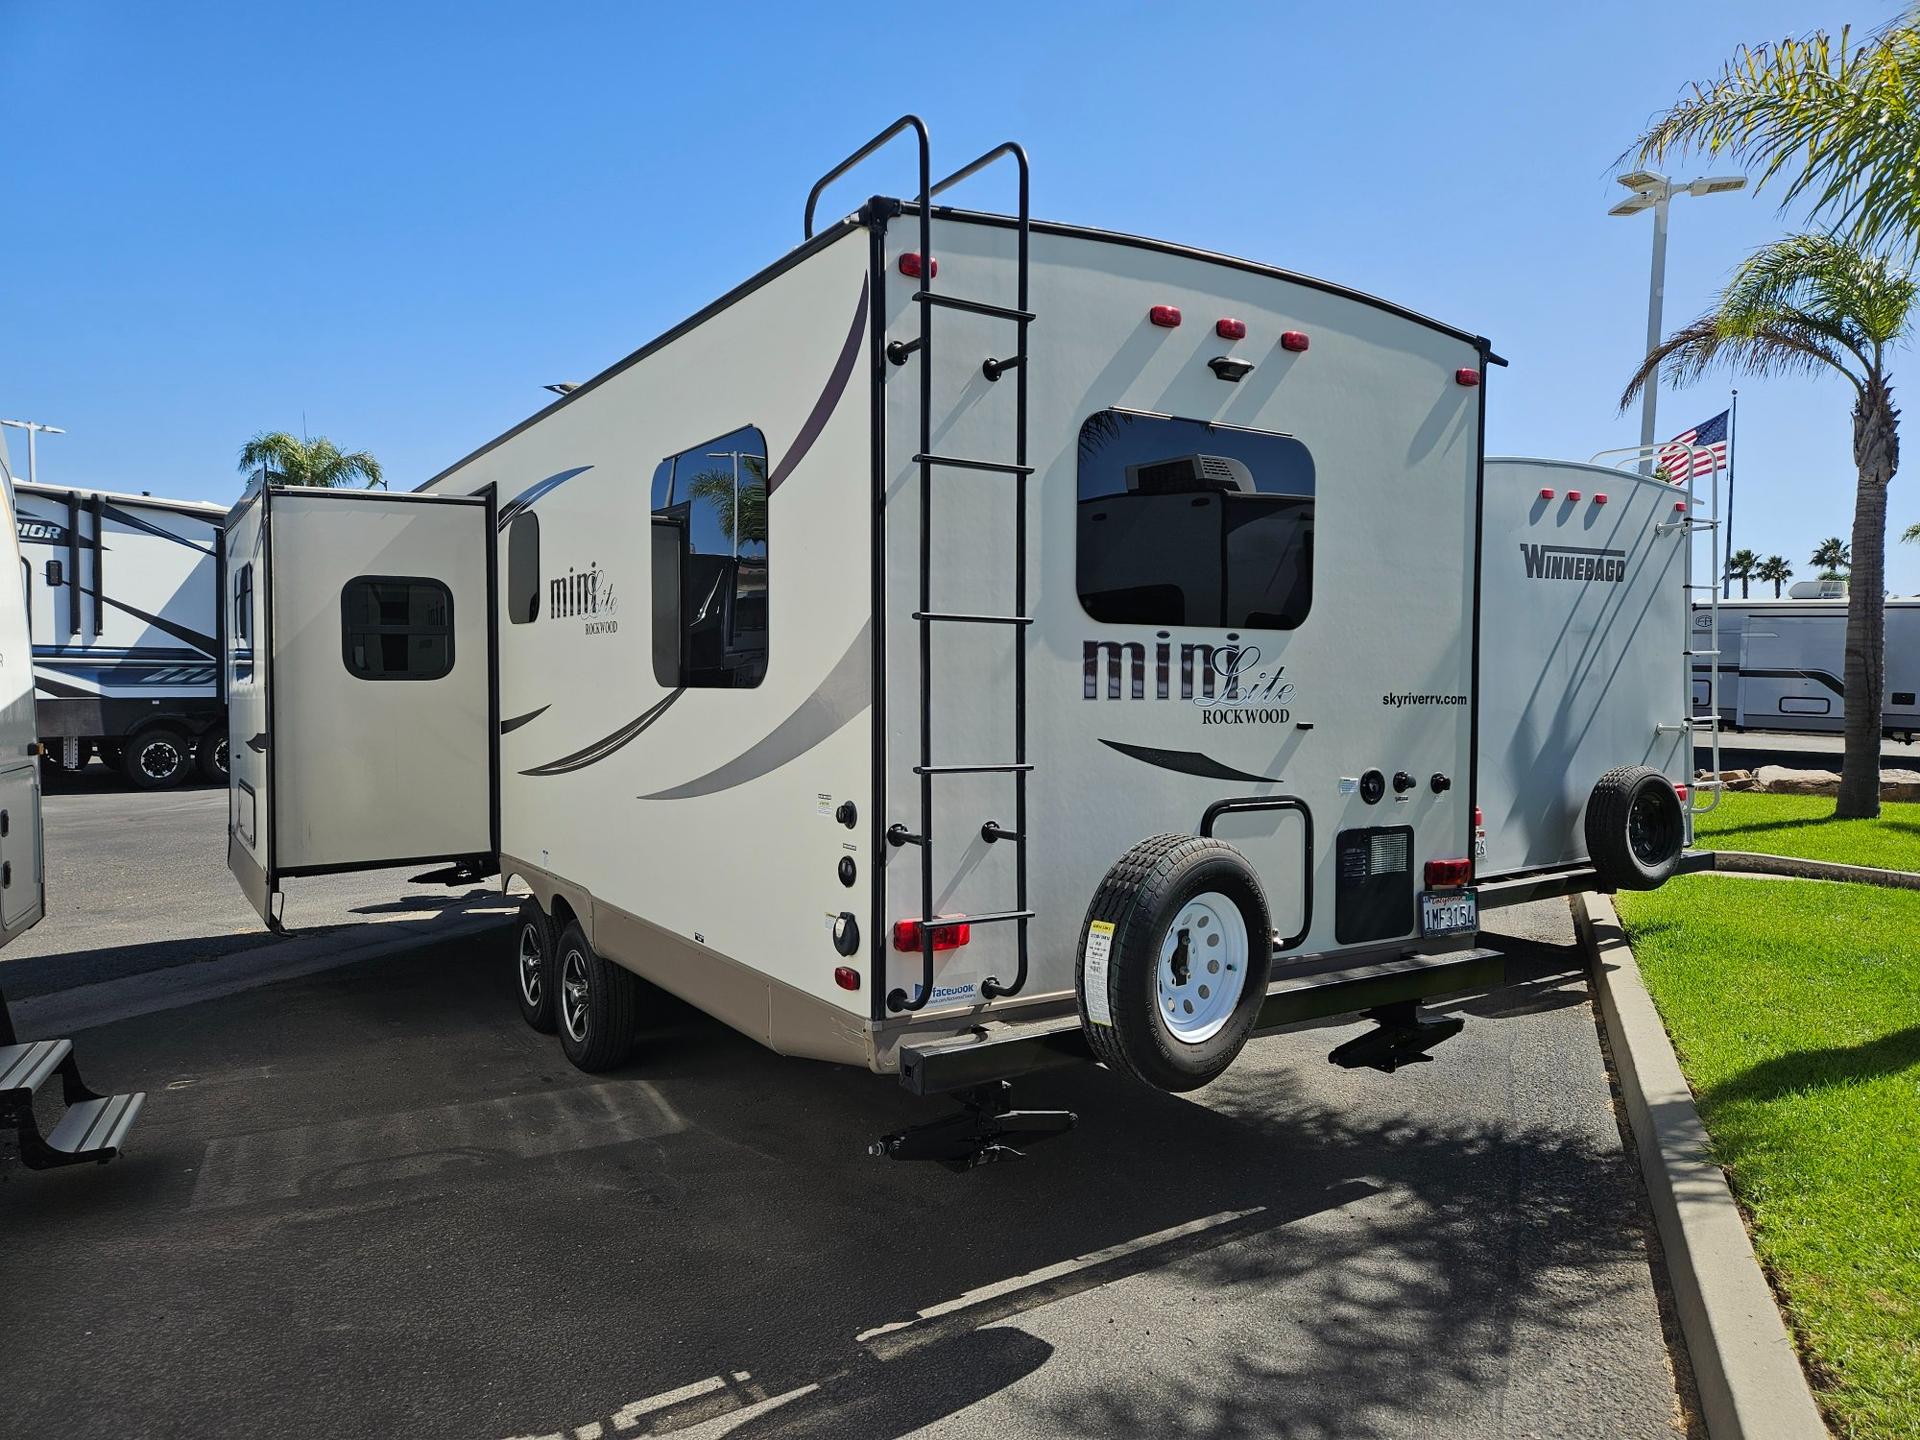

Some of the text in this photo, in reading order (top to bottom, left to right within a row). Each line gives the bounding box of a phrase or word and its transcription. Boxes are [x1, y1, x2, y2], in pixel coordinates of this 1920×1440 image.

[1519, 543, 1626, 583] WINNEBAGO
[550, 561, 619, 621] mini Lite
[585, 620, 618, 635] ROCKWOOD
[1082, 630, 1298, 708] mini Lite
[1382, 692, 1468, 708] skyriverrv.com
[1202, 708, 1290, 725] ROCKWOOD
[1425, 905, 1475, 930] 1MF3154
